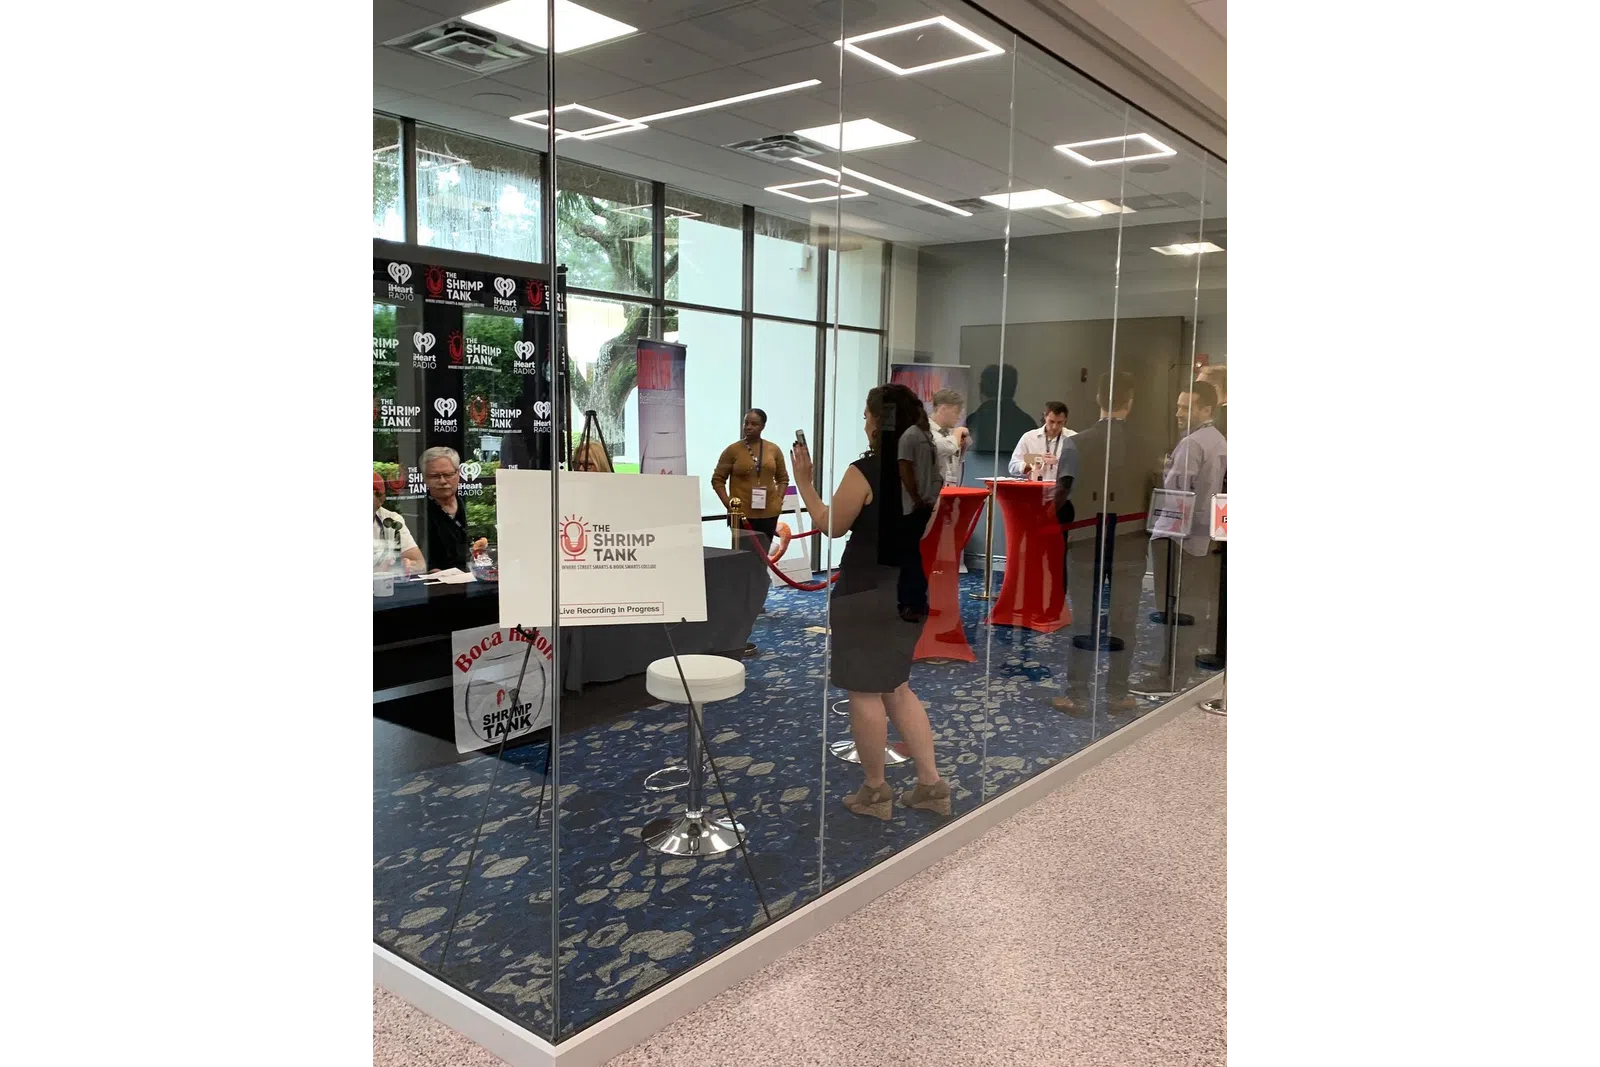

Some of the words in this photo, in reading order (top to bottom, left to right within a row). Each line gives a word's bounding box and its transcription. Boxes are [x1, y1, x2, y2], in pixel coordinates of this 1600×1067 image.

[388, 284, 414, 294] iHeart
[446, 279, 484, 291] SHRIMP
[388, 292, 415, 301] RADIO
[446, 290, 472, 301] TANK
[493, 297, 517, 306] iHeart
[493, 305, 518, 313] RADIO
[372, 337, 399, 349] RIMP
[466, 344, 502, 357] SHRIMP
[412, 353, 436, 362] iHeart
[466, 354, 493, 366] TANK
[412, 361, 437, 370] RADIO
[513, 360, 536, 369] iHeart
[513, 367, 536, 375] RADIO
[381, 405, 421, 417] SHRIMP
[490, 408, 522, 419] SHRIMP
[381, 416, 412, 427] TANK
[434, 418, 458, 426] iHeart
[490, 418, 512, 429] TANK
[434, 425, 458, 433] RADIO
[408, 483, 427, 494] TAN
[457, 482, 483, 490] iHeart
[457, 489, 484, 497] RADIO
[592, 524, 610, 532] THE
[593, 533, 656, 547] SHRIMP
[593, 548, 638, 562] TANK
[577, 606, 616, 614] Recording
[627, 605, 660, 613] Progress
[455, 631, 504, 673] Boca
[483, 713, 532, 739] TANK
